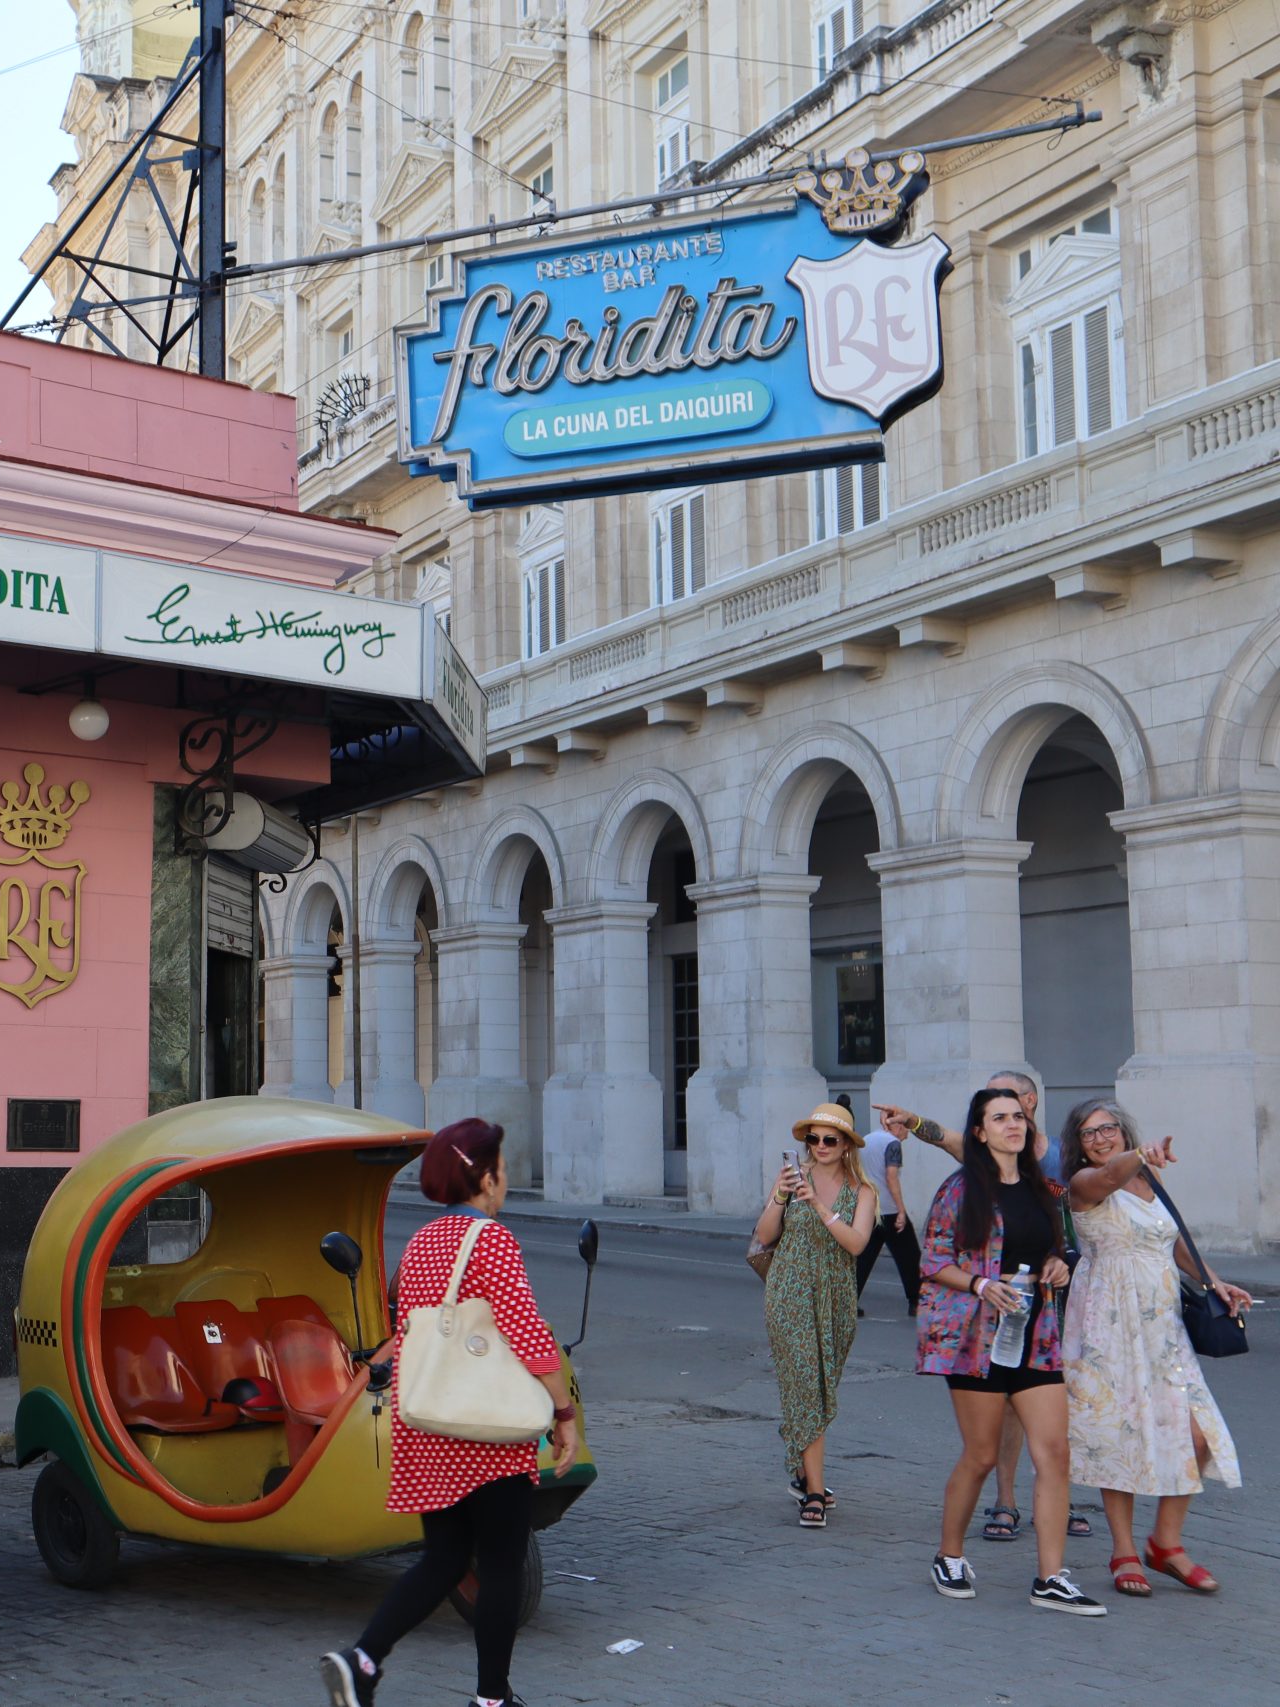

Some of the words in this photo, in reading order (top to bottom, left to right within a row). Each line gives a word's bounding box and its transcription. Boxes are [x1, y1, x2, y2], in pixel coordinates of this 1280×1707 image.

[536, 232, 722, 281] RESTAURANTE
[603, 265, 656, 293] BAR
[523, 419, 548, 440] LA
[554, 411, 609, 437] CUNA
[615, 405, 653, 429] DEL
[660, 391, 754, 423] DAIQUIRI
[125, 584, 245, 646] Ernest
[443, 656, 473, 736] Floridita
